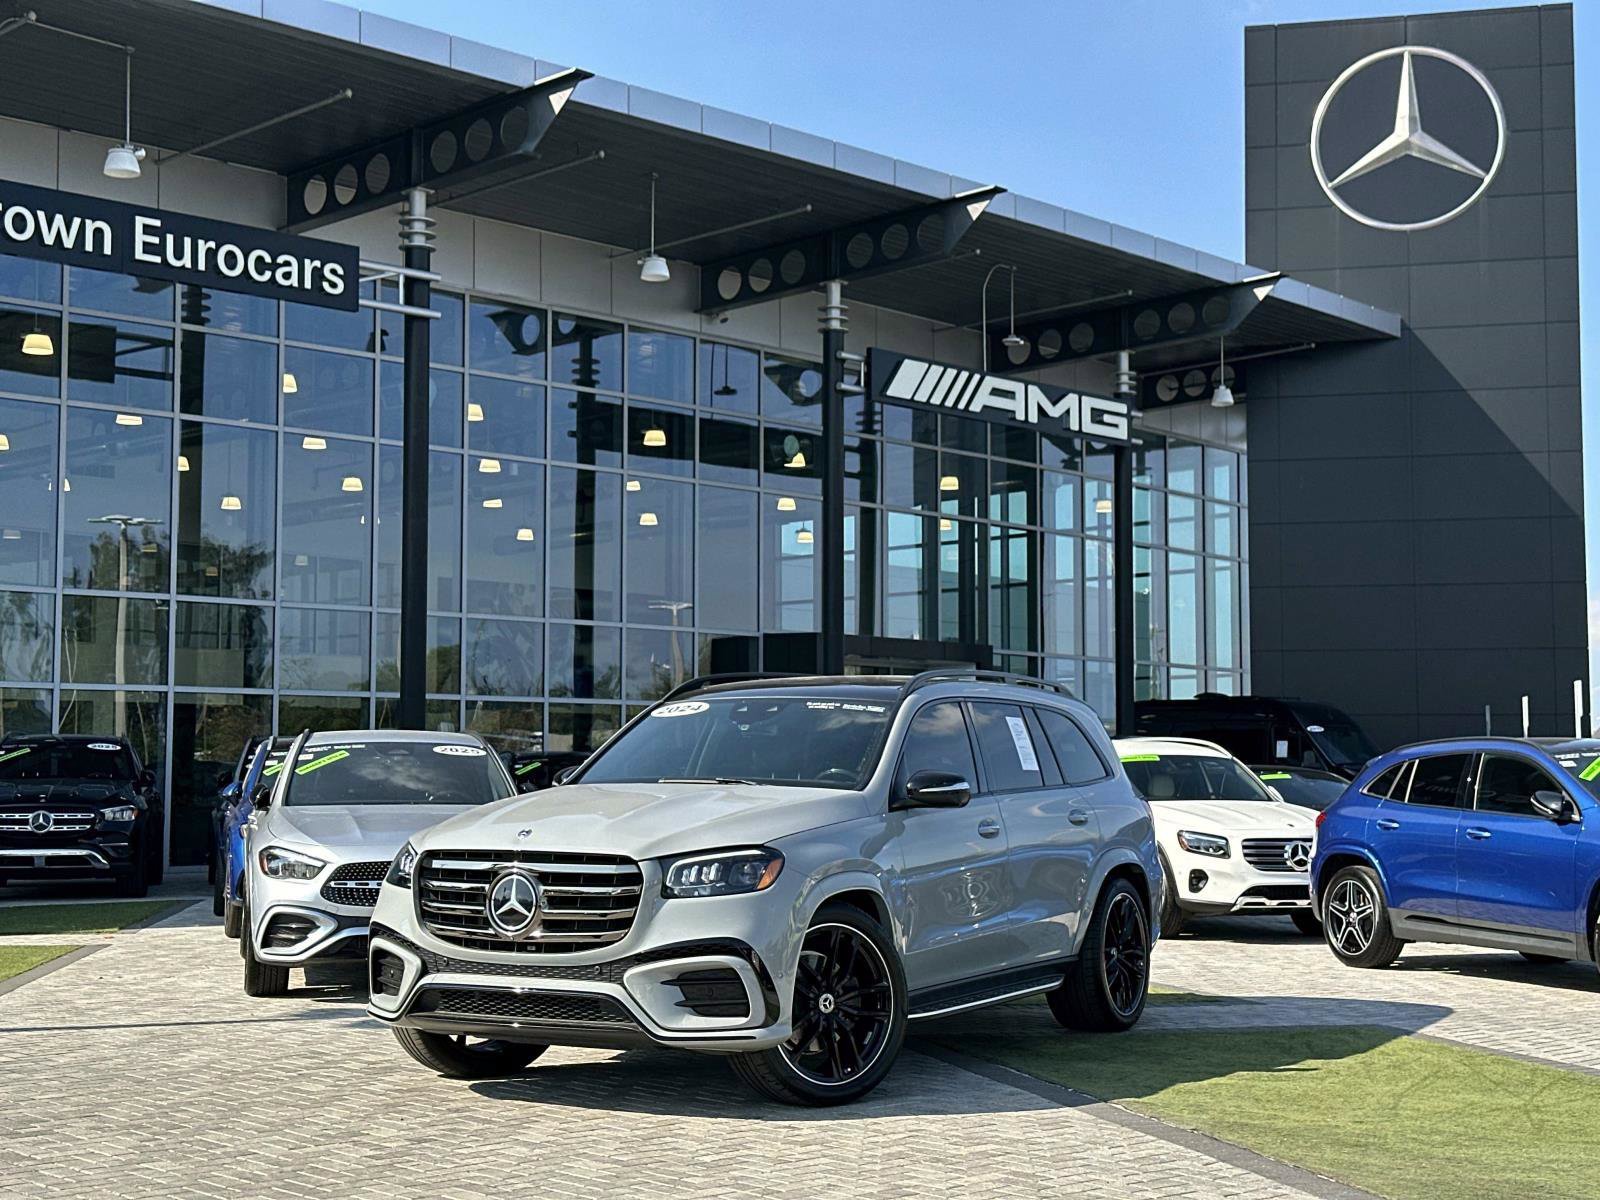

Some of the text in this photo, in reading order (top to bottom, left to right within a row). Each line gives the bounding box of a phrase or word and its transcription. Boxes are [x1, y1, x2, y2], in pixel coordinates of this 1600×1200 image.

[134, 215, 346, 296] Eurocars
[968, 375, 1129, 440] AMG
[657, 704, 703, 714] 2024
[440, 746, 480, 755] 2025
